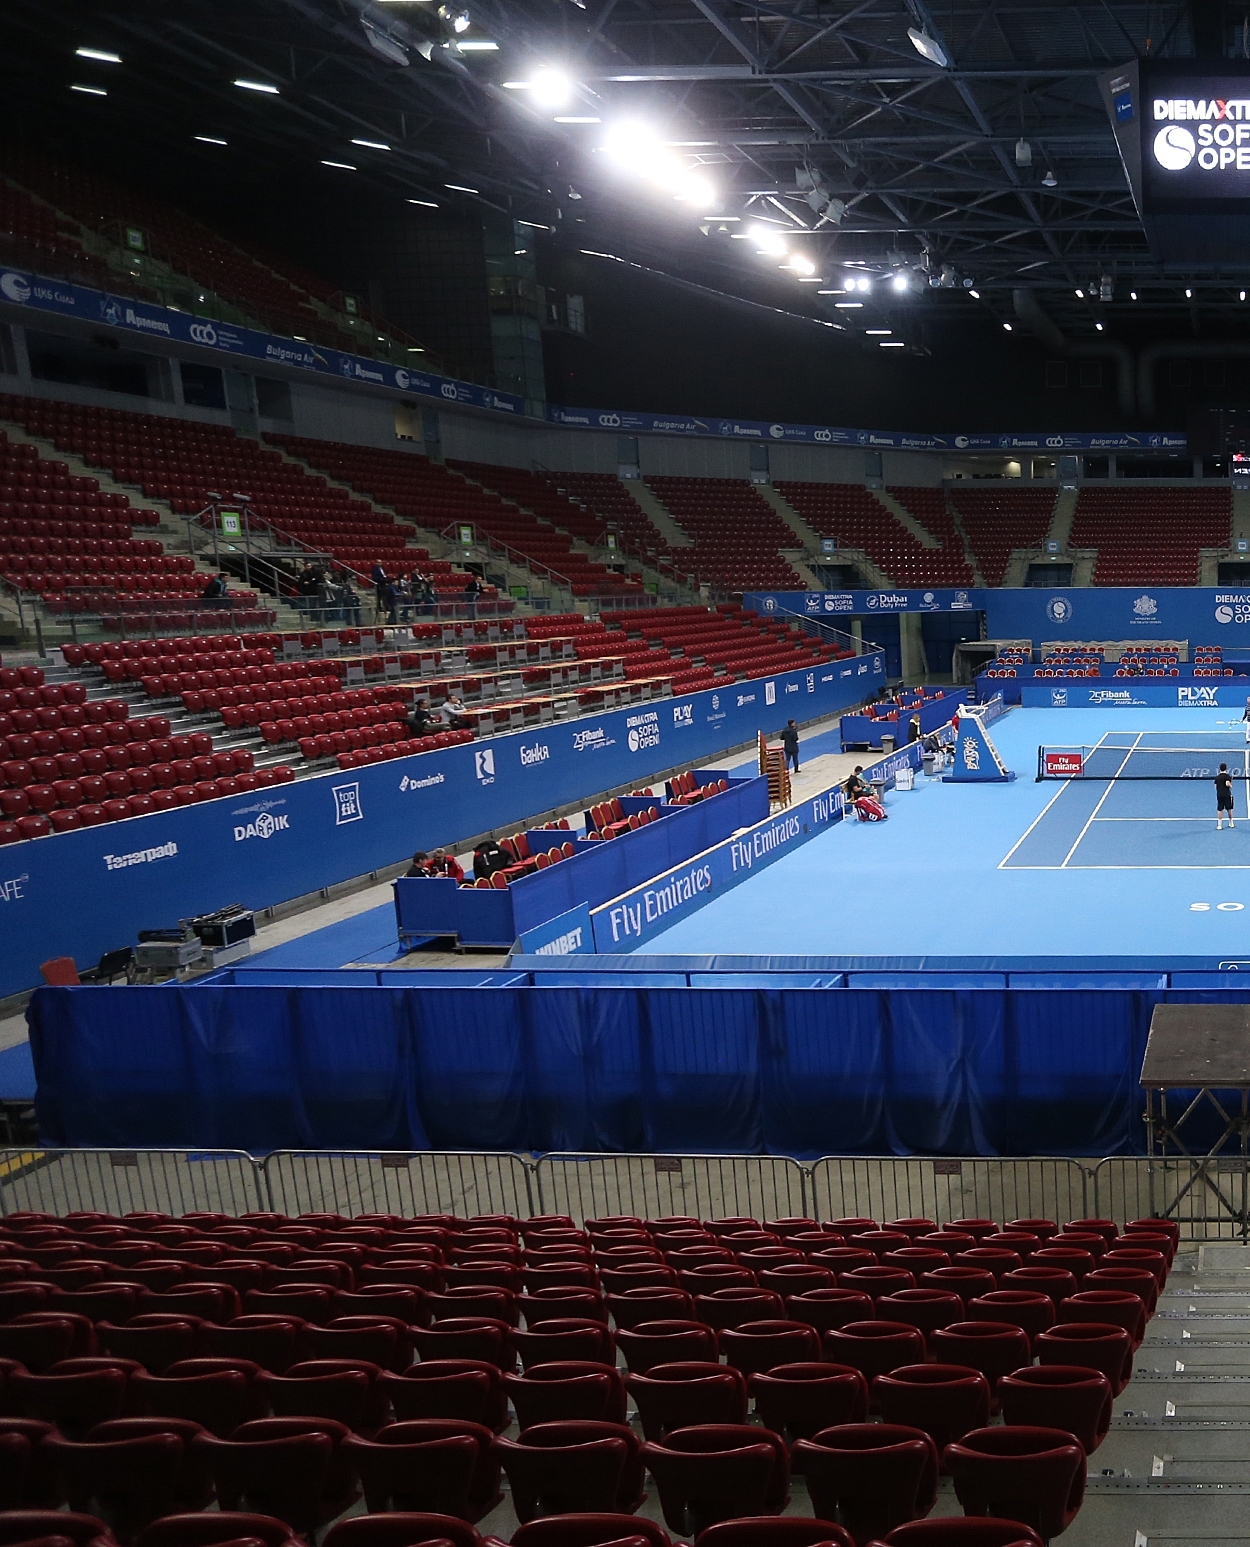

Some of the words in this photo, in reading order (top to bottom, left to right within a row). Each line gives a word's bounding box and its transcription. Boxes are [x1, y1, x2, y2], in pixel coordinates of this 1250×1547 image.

[126, 308, 170, 334] Армеец
[266, 344, 303, 362] Bulgaria
[303, 353, 314, 364] Air
[879, 594, 908, 603] Dubai
[1089, 691, 1101, 703] 25
[1101, 690, 1130, 698] Fibank
[1178, 686, 1218, 701] PLAY
[673, 704, 693, 722] PLAY
[582, 727, 604, 741] Fibank
[638, 724, 660, 738] SOFIA
[639, 734, 658, 749] OPEN
[1047, 763, 1080, 771] Emirates
[1181, 768, 1210, 777] ATP
[410, 772, 445, 790] Domino's
[339, 791, 355, 803] top
[341, 801, 356, 816] fit
[813, 797, 828, 823] Fly
[730, 841, 752, 872] Fly
[753, 814, 800, 859] Emirates
[609, 902, 642, 942] Fly
[643, 864, 712, 923] Emirates
